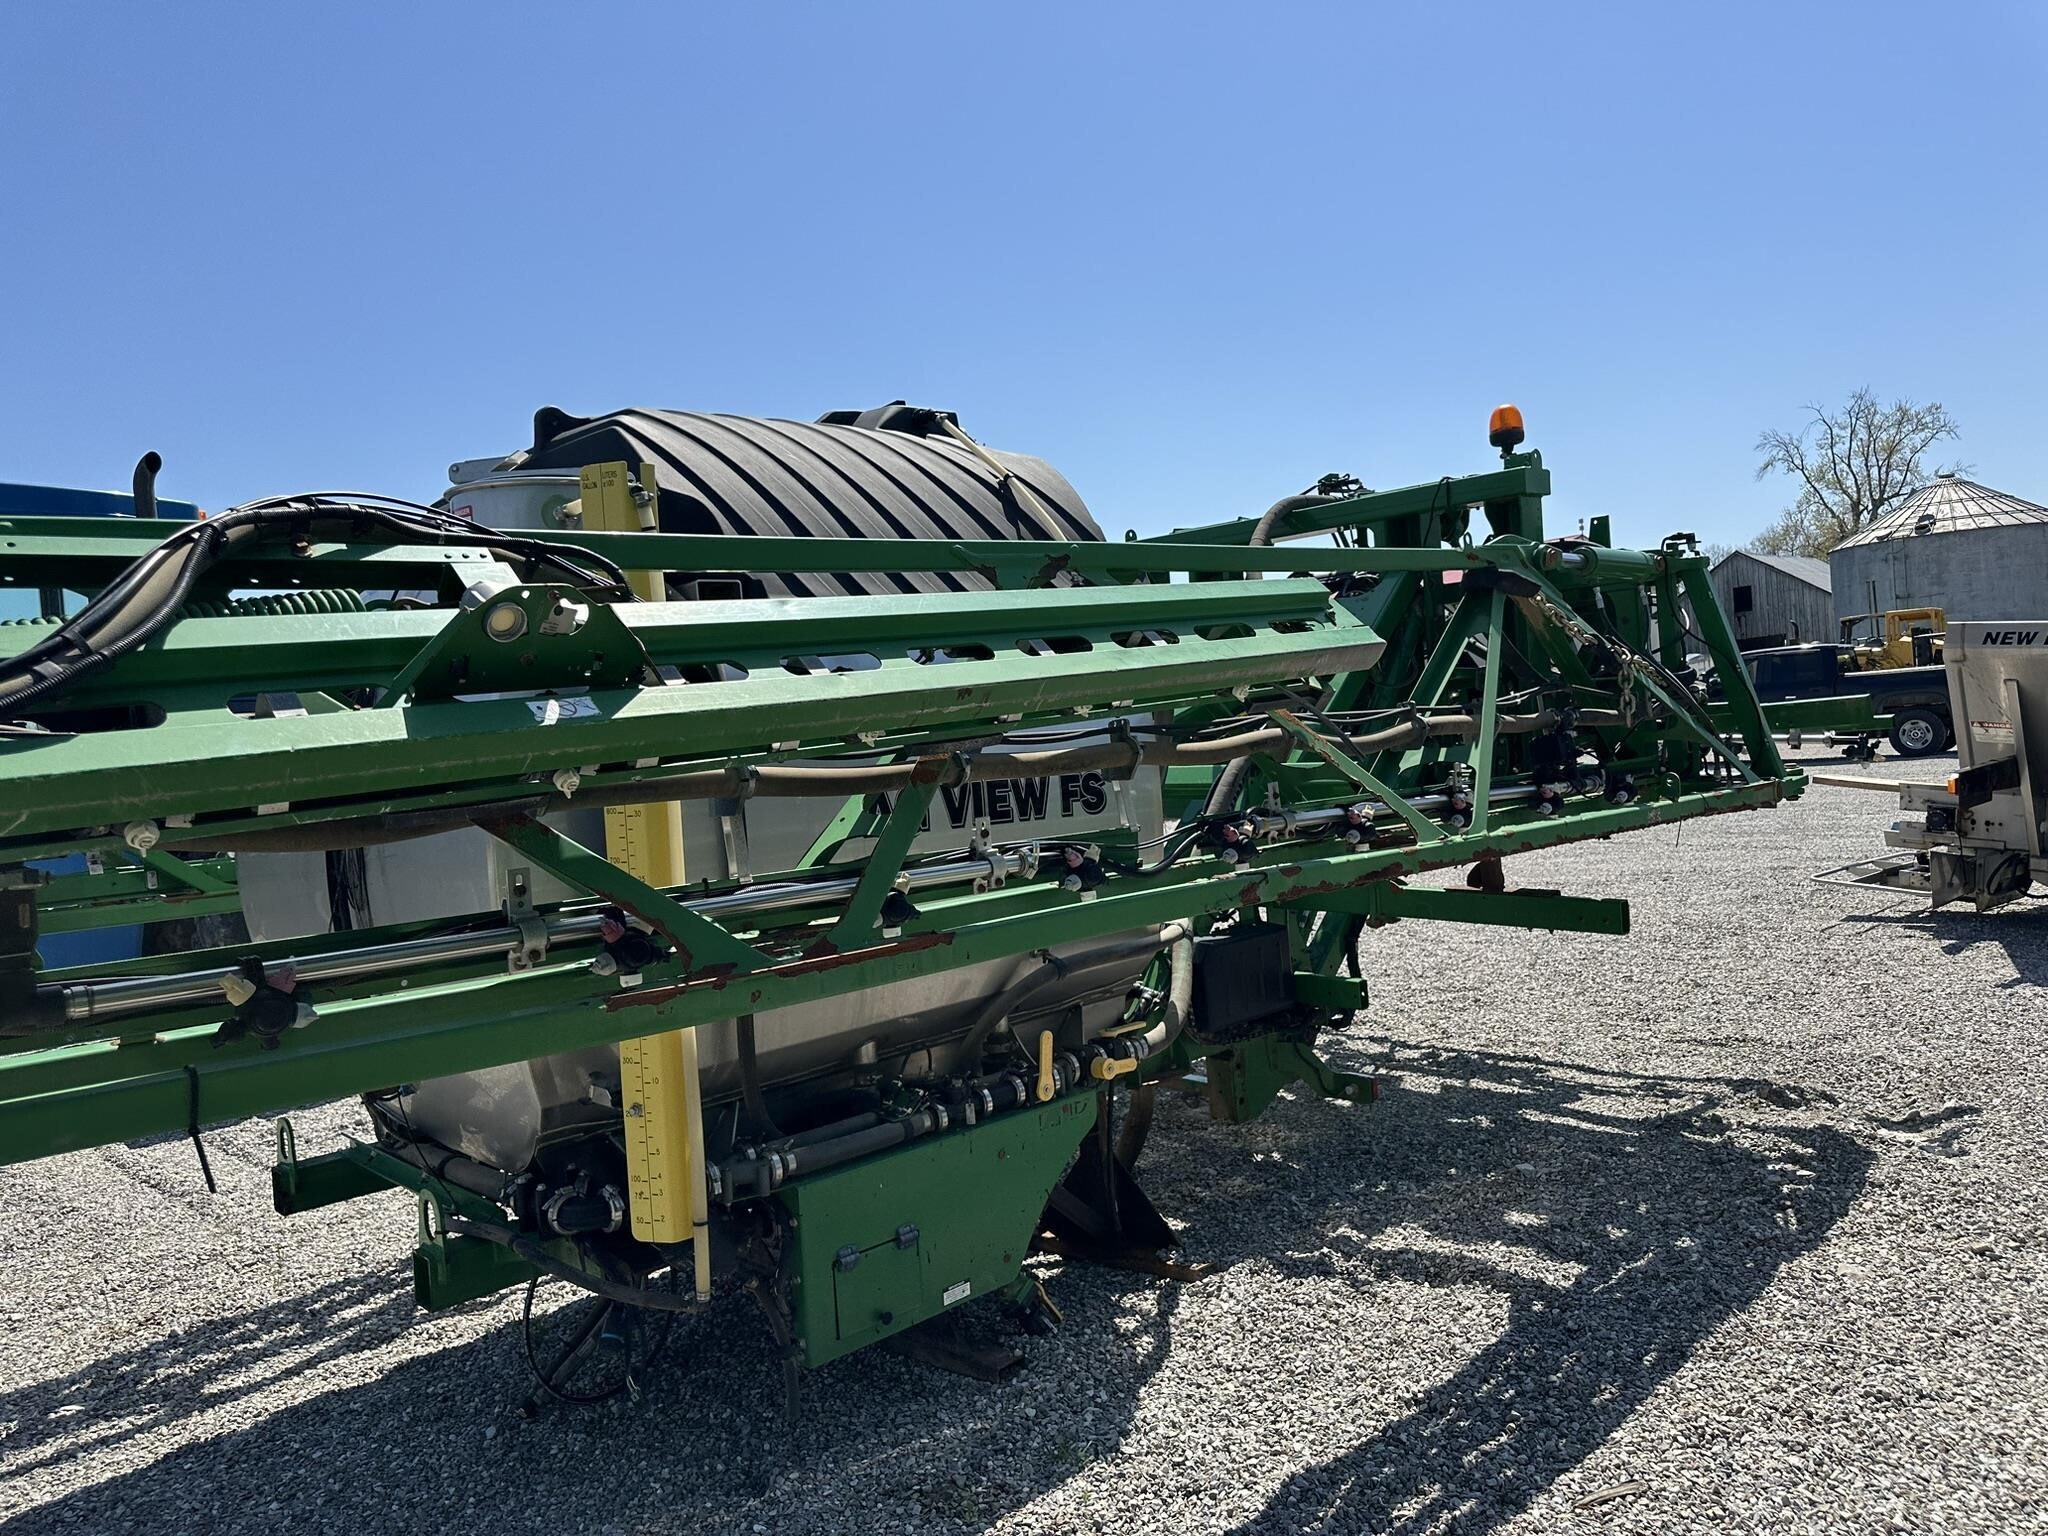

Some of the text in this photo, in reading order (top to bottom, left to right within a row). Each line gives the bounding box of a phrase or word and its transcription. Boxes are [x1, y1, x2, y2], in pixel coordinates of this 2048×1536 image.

[1982, 631, 2040, 646] NEW
[938, 776, 1051, 830] VIEW
[1060, 771, 1107, 817] FS
[652, 1076, 660, 1085] 10
[631, 1175, 641, 1183] 100
